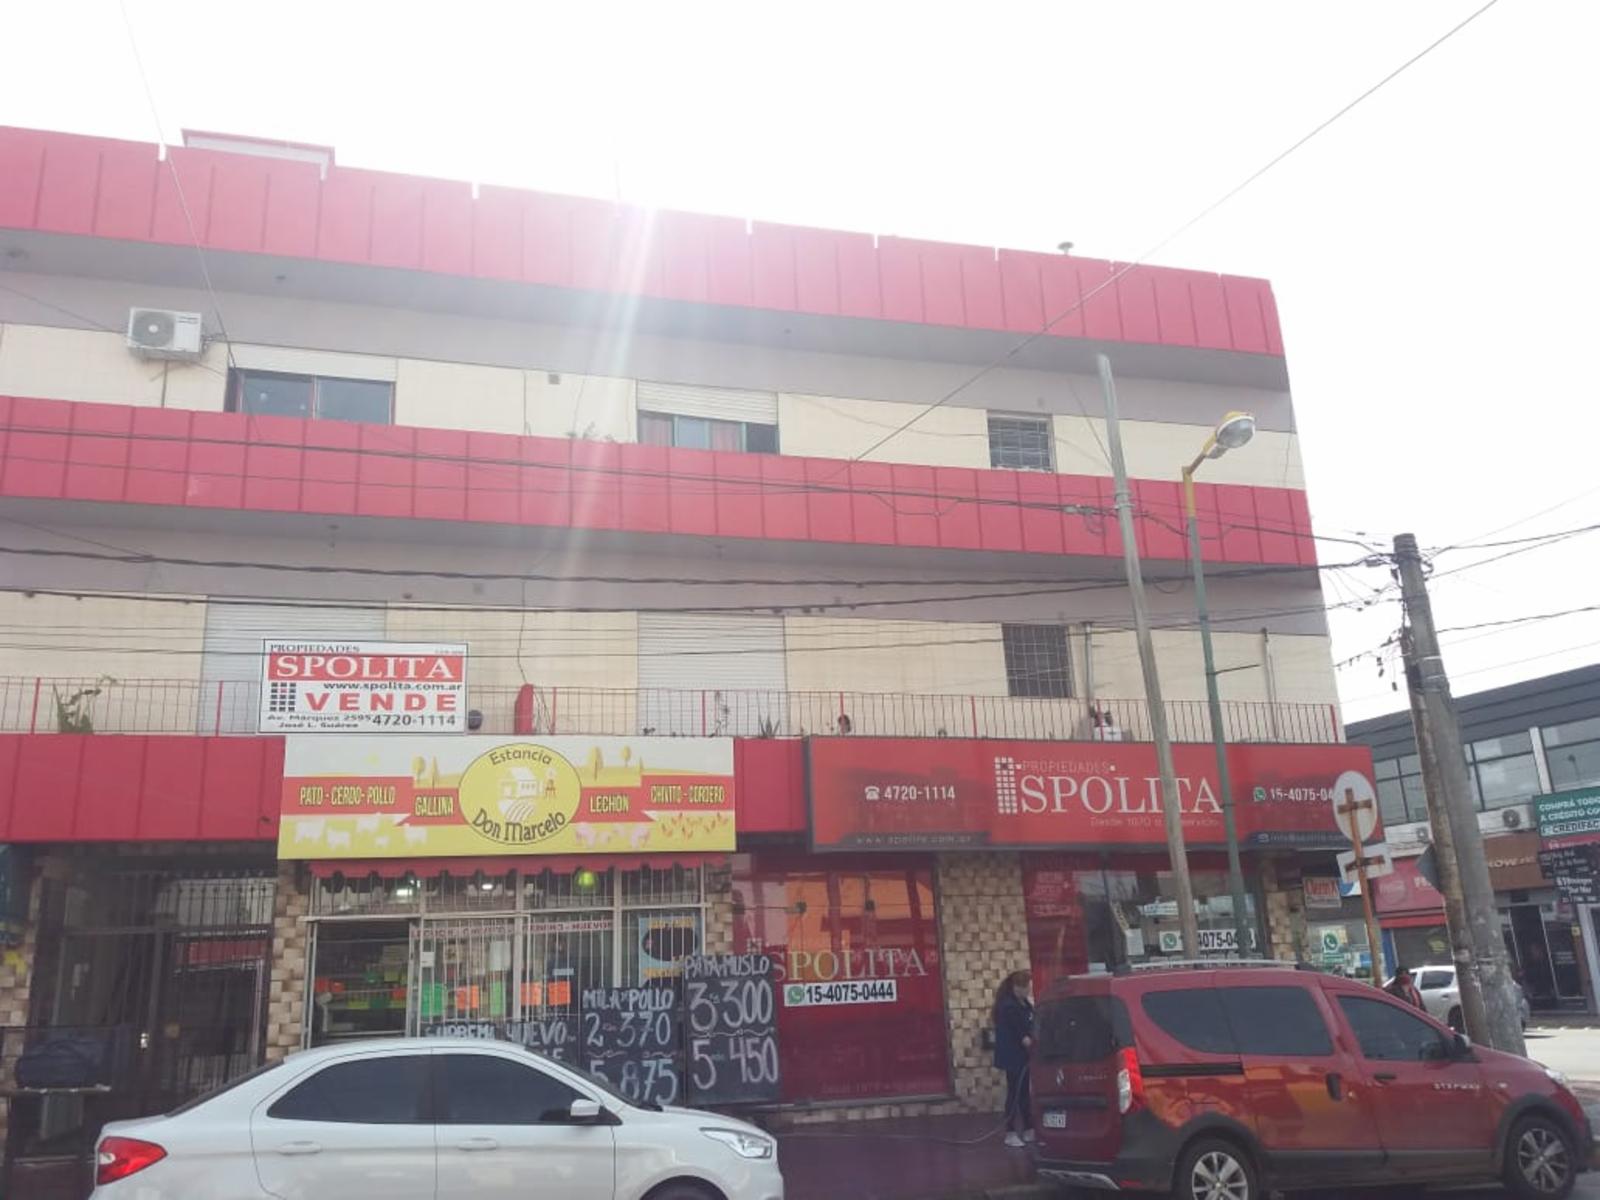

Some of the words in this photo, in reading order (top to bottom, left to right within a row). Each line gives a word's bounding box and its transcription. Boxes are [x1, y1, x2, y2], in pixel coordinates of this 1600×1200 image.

[270, 644, 360, 653] PROPIEDADES
[276, 656, 455, 679] SPOLITA
[323, 681, 463, 692] www.spolita.com.ar
[305, 692, 457, 712] VENDE
[372, 714, 456, 727] 4720-1114
[488, 749, 552, 766] Estancia
[1022, 760, 1110, 774] PROPIEDADES
[299, 786, 324, 806] PATO
[331, 785, 362, 806] CERDO
[367, 785, 396, 805] POLLO
[884, 785, 956, 801] 4720-1114
[1020, 774, 1224, 814] SPOLITA
[1269, 787, 1335, 802] 15-4075-04
[415, 796, 454, 817] GALLINA
[472, 808, 502, 839] Don
[504, 812, 566, 842] Marcelo
[771, 948, 929, 982] SPOLITA
[629, 988, 674, 1011] POLLO
[806, 981, 894, 1002] 15-4075-0444
[720, 979, 773, 1028] 300
[585, 1012, 604, 1047] 2
[616, 1011, 671, 1048] 370
[692, 1039, 718, 1090] 5
[729, 1037, 780, 1084] 450
[619, 1058, 678, 1105] 875
